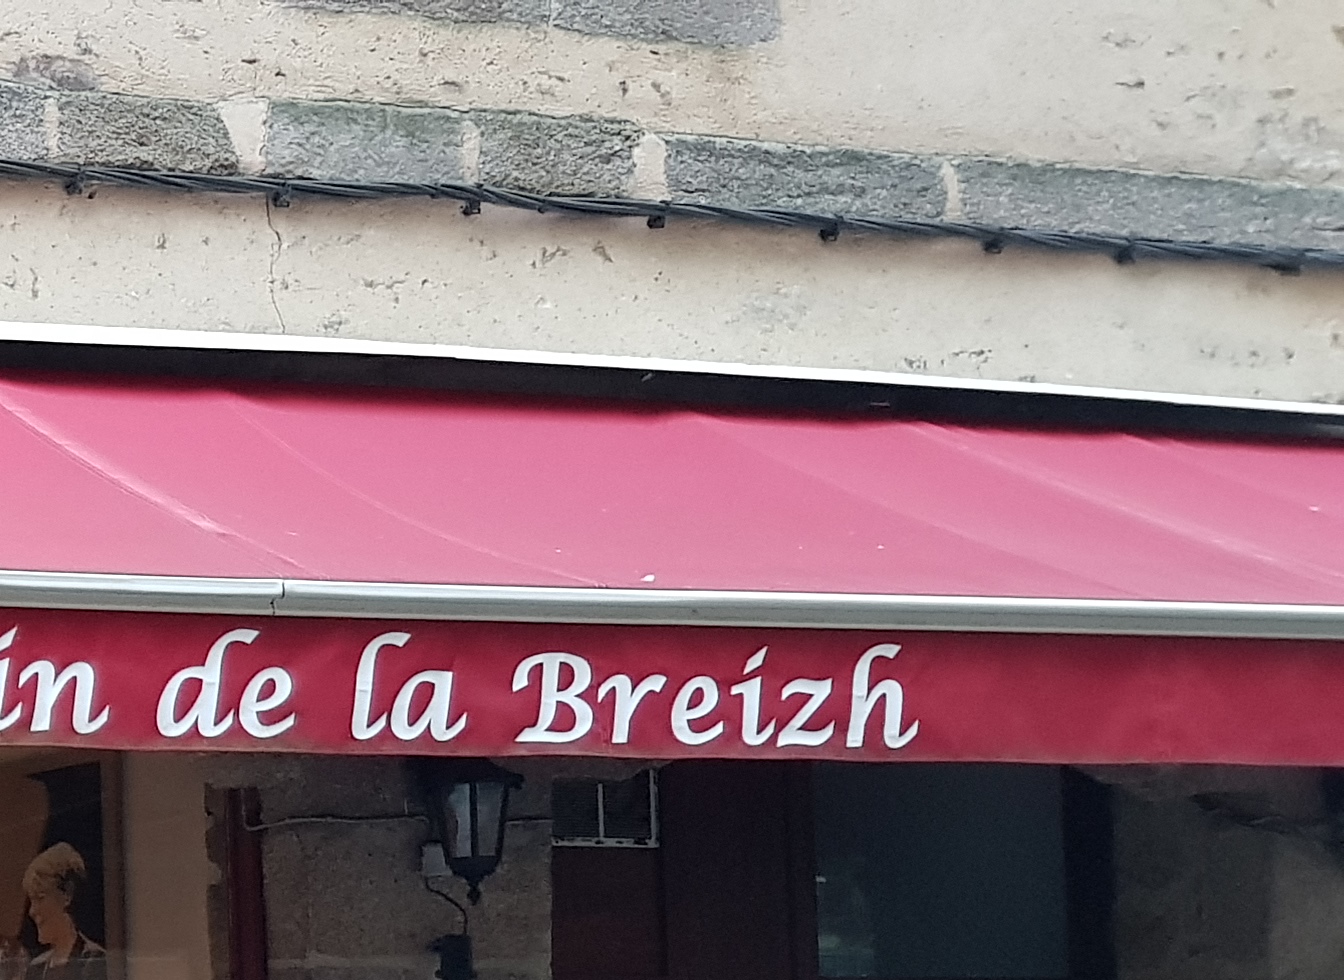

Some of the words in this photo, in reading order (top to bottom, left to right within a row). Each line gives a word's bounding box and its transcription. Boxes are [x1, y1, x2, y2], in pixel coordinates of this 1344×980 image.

[156, 627, 297, 740] de
[350, 631, 468, 743] la
[512, 643, 920, 750] Breizh
